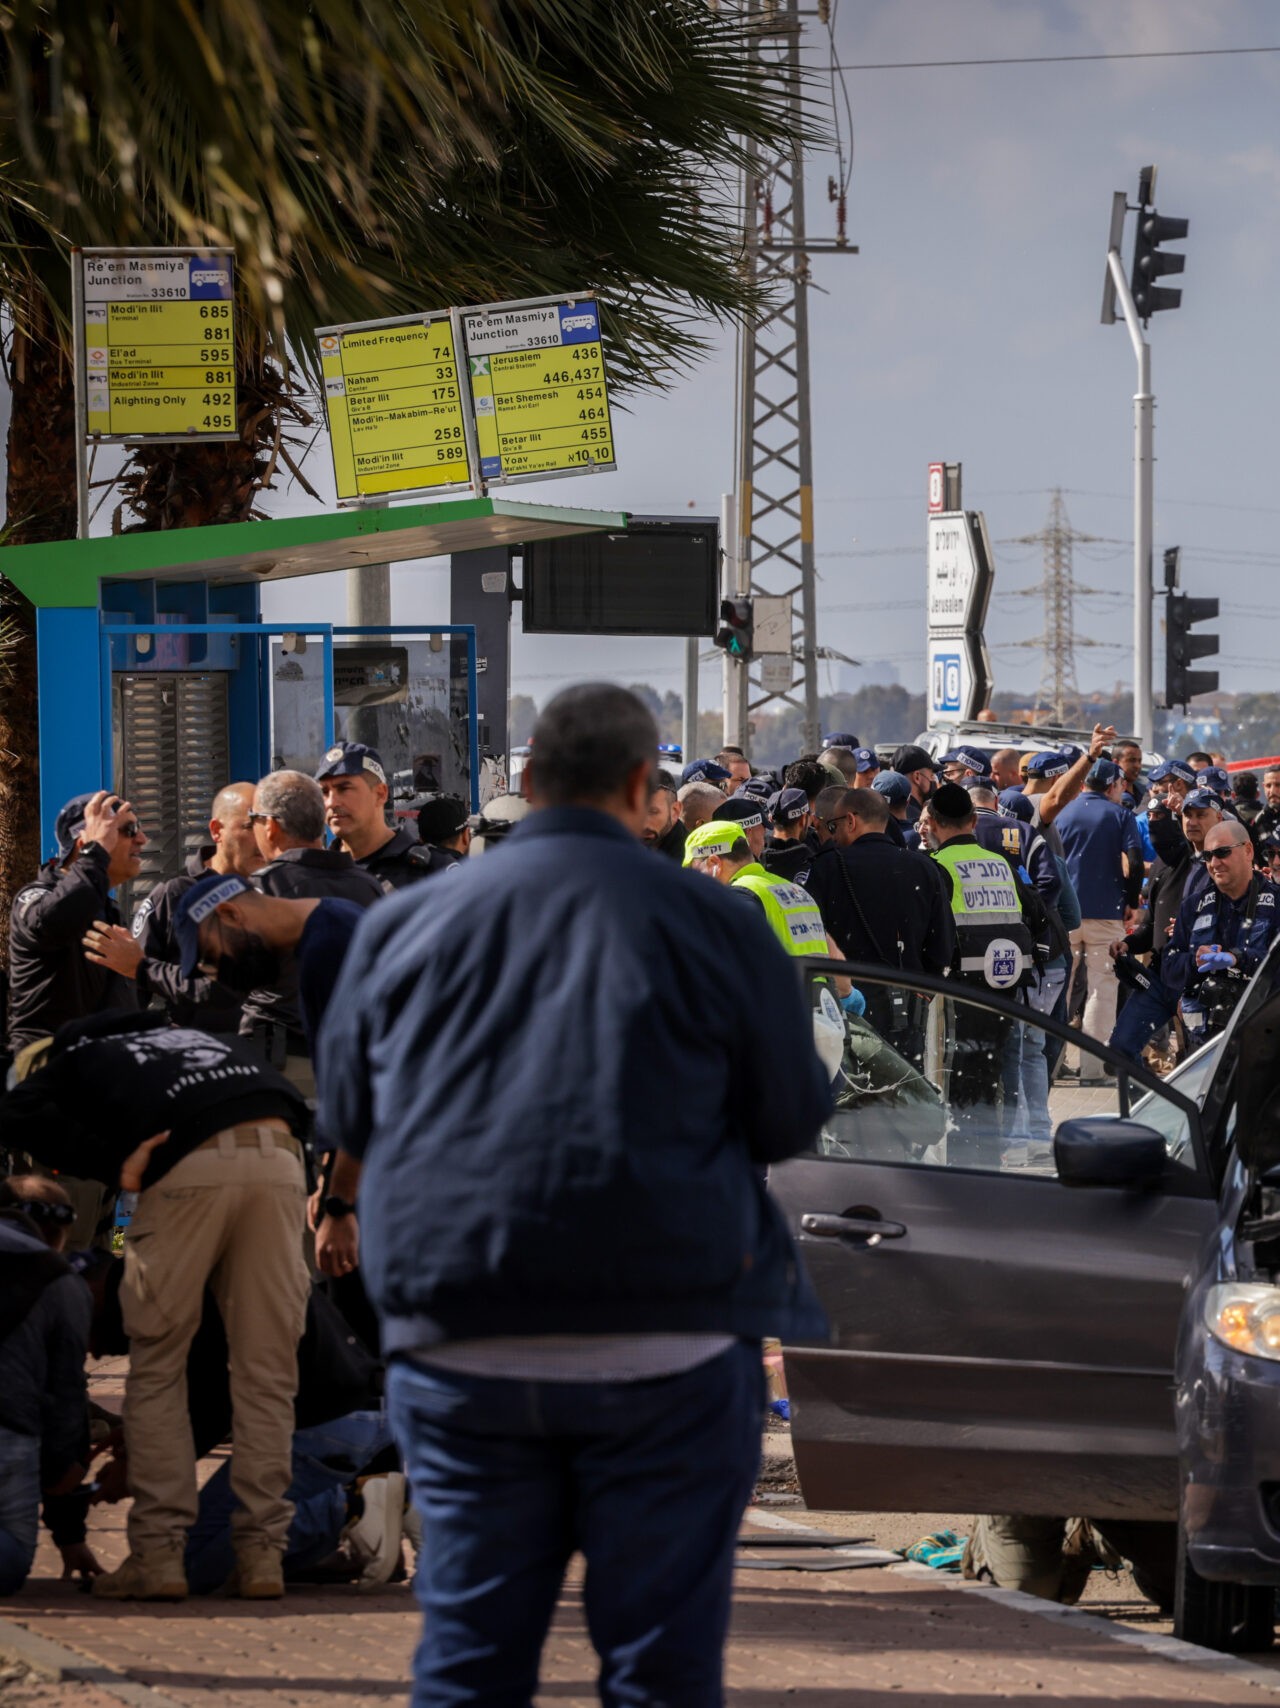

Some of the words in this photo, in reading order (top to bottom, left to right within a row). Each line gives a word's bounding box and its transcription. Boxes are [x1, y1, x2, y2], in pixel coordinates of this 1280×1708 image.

[88, 261, 126, 272] Re'em
[129, 260, 184, 273] Masmiya
[88, 275, 142, 285] Junction
[151, 287, 186, 298] 33610
[111, 305, 147, 313] Modi'in
[200, 306, 229, 318] 685
[468, 317, 503, 329] Reem
[505, 311, 555, 324] Masmiya
[204, 327, 230, 340] 881
[342, 337, 377, 349] Limited
[379, 331, 429, 344] Frequency
[470, 328, 518, 341] Junction
[527, 334, 559, 347] 33610
[110, 349, 136, 357] El'ad
[200, 349, 229, 361] 595
[432, 346, 450, 359] 74
[493, 352, 541, 365] Jerusalem
[572, 347, 598, 360] 436
[436, 367, 453, 379] 33
[493, 364, 515, 372] Central
[111, 371, 148, 379] Modi'in
[205, 371, 232, 384] 881
[347, 375, 379, 385] Naham
[543, 367, 600, 384] 446,437
[202, 393, 231, 406] 492
[432, 386, 456, 400] 175
[497, 396, 514, 405] Bet
[516, 390, 558, 403] Shemesh
[577, 387, 603, 400] 454
[114, 396, 160, 406] Alighting
[163, 396, 186, 406] Only
[350, 396, 376, 405] Betar
[579, 407, 605, 420] 464
[203, 415, 231, 427] 495
[434, 426, 461, 440] 258
[581, 427, 607, 440] 455
[502, 436, 527, 445] Betar
[357, 455, 390, 466] Modi'in
[437, 447, 463, 461] 589
[504, 455, 528, 464] Yoav
[358, 464, 385, 472] Industrial
[931, 594, 964, 613] Jerusalem
